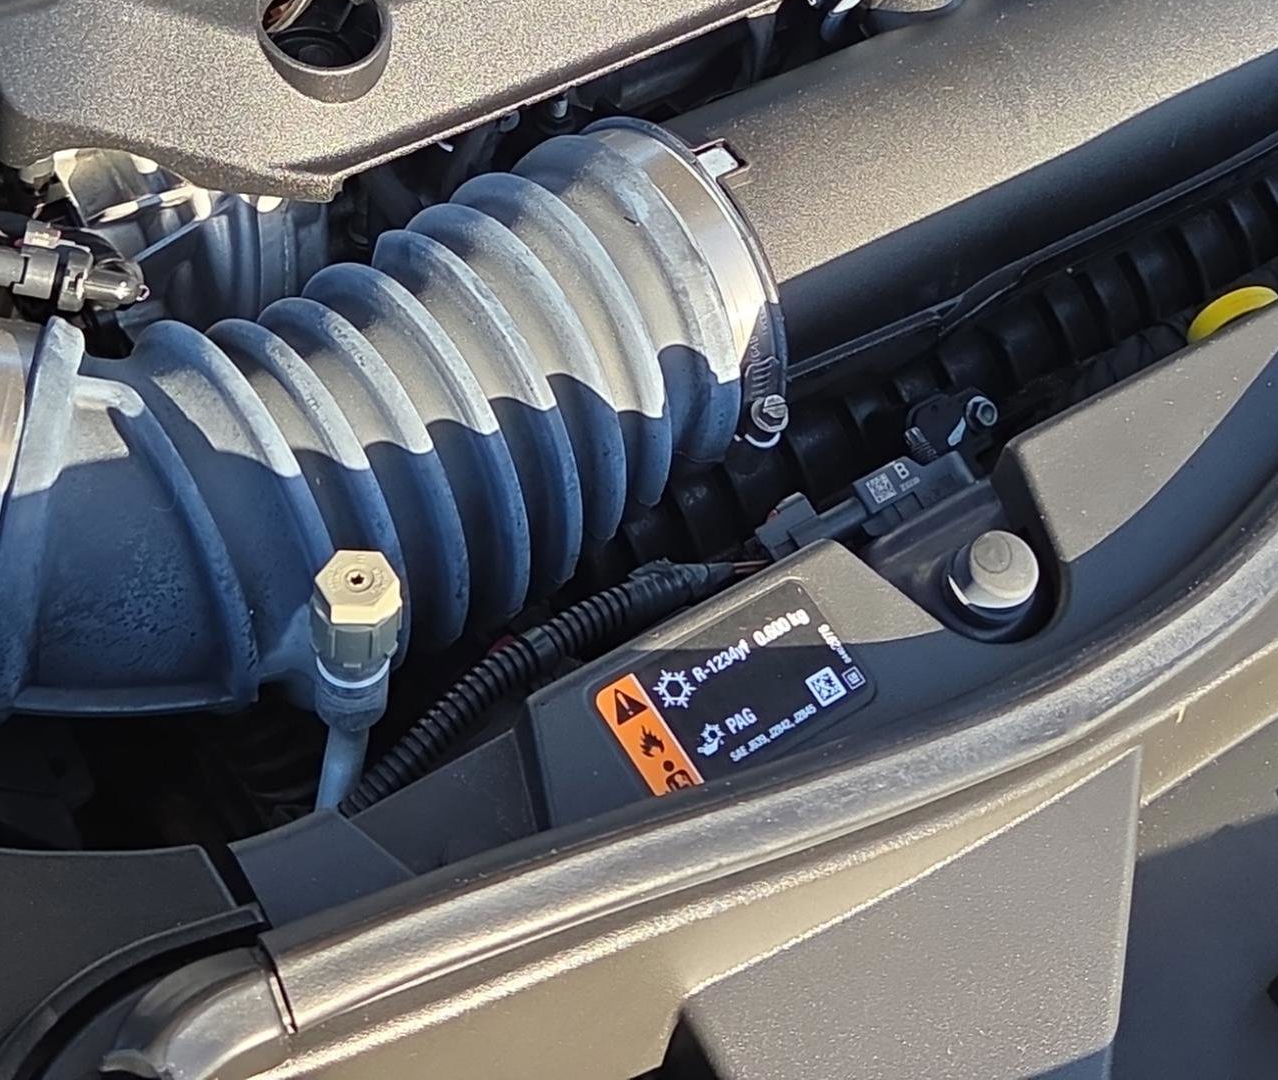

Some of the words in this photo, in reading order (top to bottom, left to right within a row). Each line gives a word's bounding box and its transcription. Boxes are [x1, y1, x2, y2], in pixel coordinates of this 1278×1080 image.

[894, 462, 909, 479] B
[691, 638, 751, 683] R-1234yf
[786, 608, 811, 628] kg
[725, 707, 758, 735] PAG
[729, 745, 750, 763] SAE
